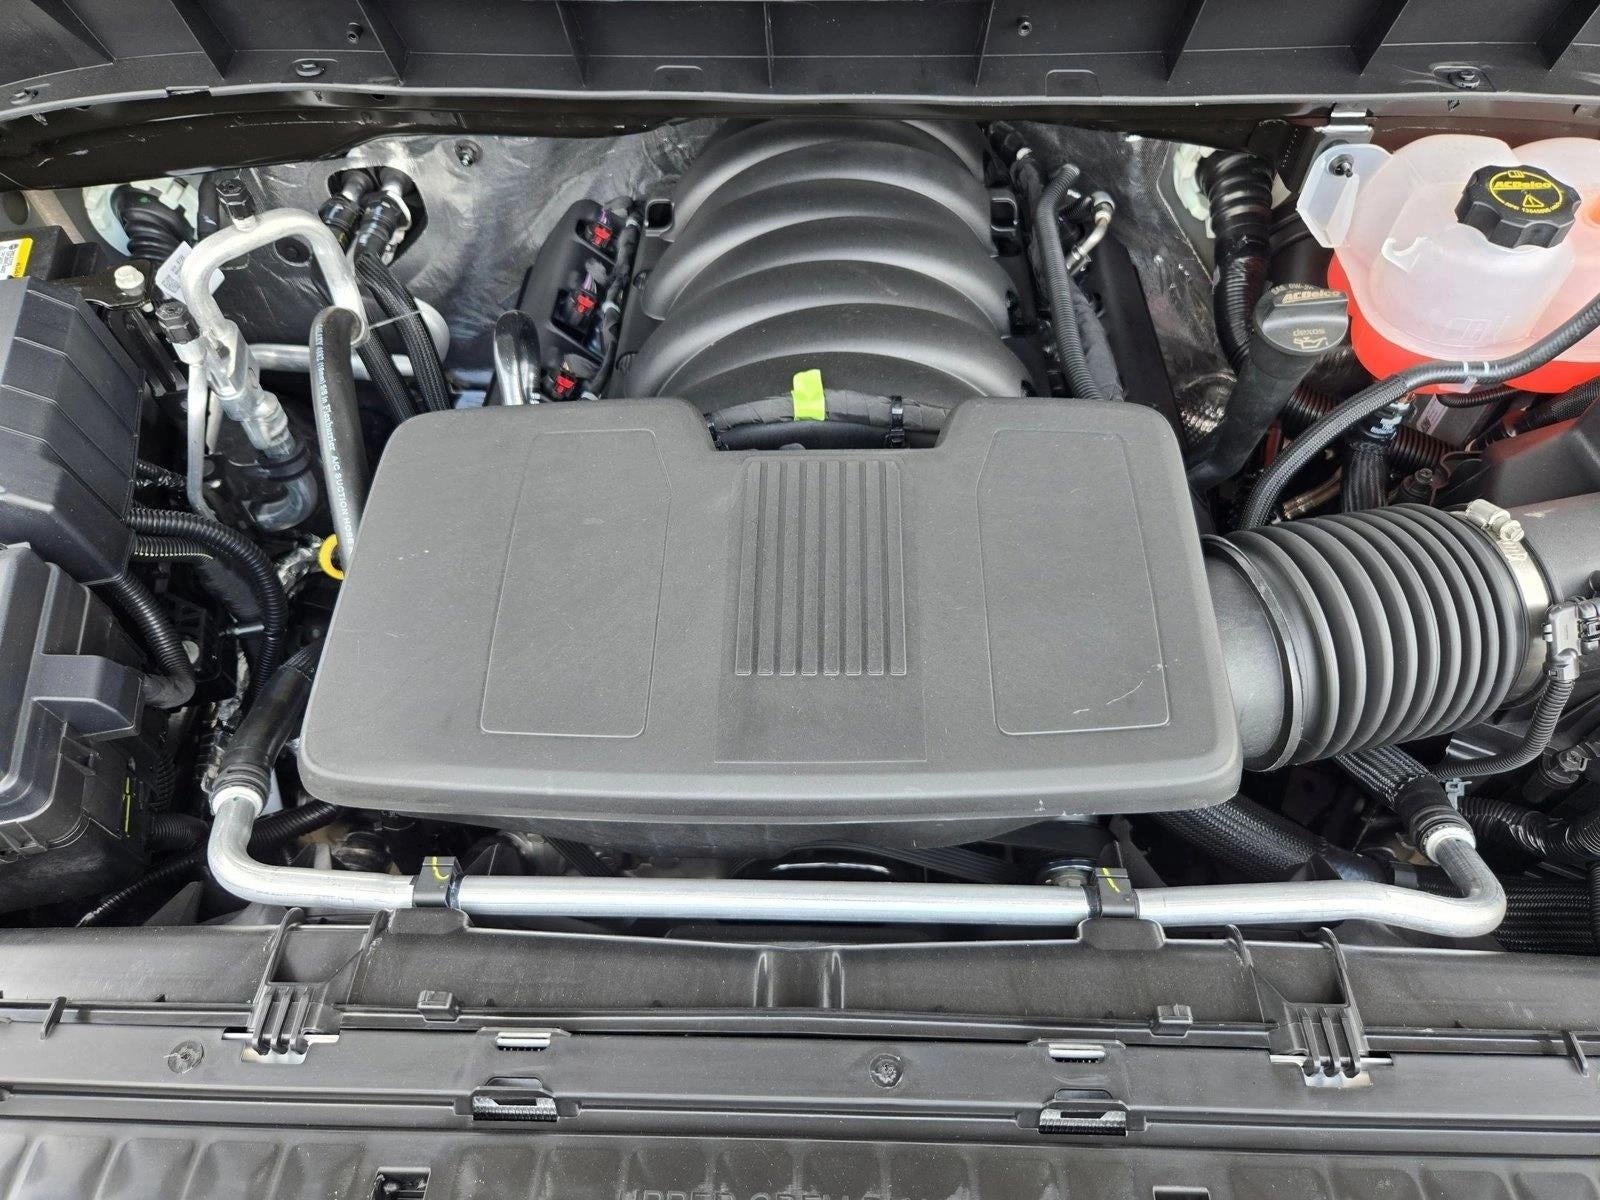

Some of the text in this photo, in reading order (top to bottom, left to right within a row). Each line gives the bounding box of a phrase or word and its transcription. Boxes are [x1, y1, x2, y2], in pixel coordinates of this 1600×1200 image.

[1493, 181, 1552, 190] ACDelco
[1282, 289, 1341, 304] ACDelco
[323, 404, 336, 451] Flexbarrier
[331, 455, 341, 471] A/C
[335, 473, 349, 515] SUCTION
[343, 517, 355, 544] HOSE
